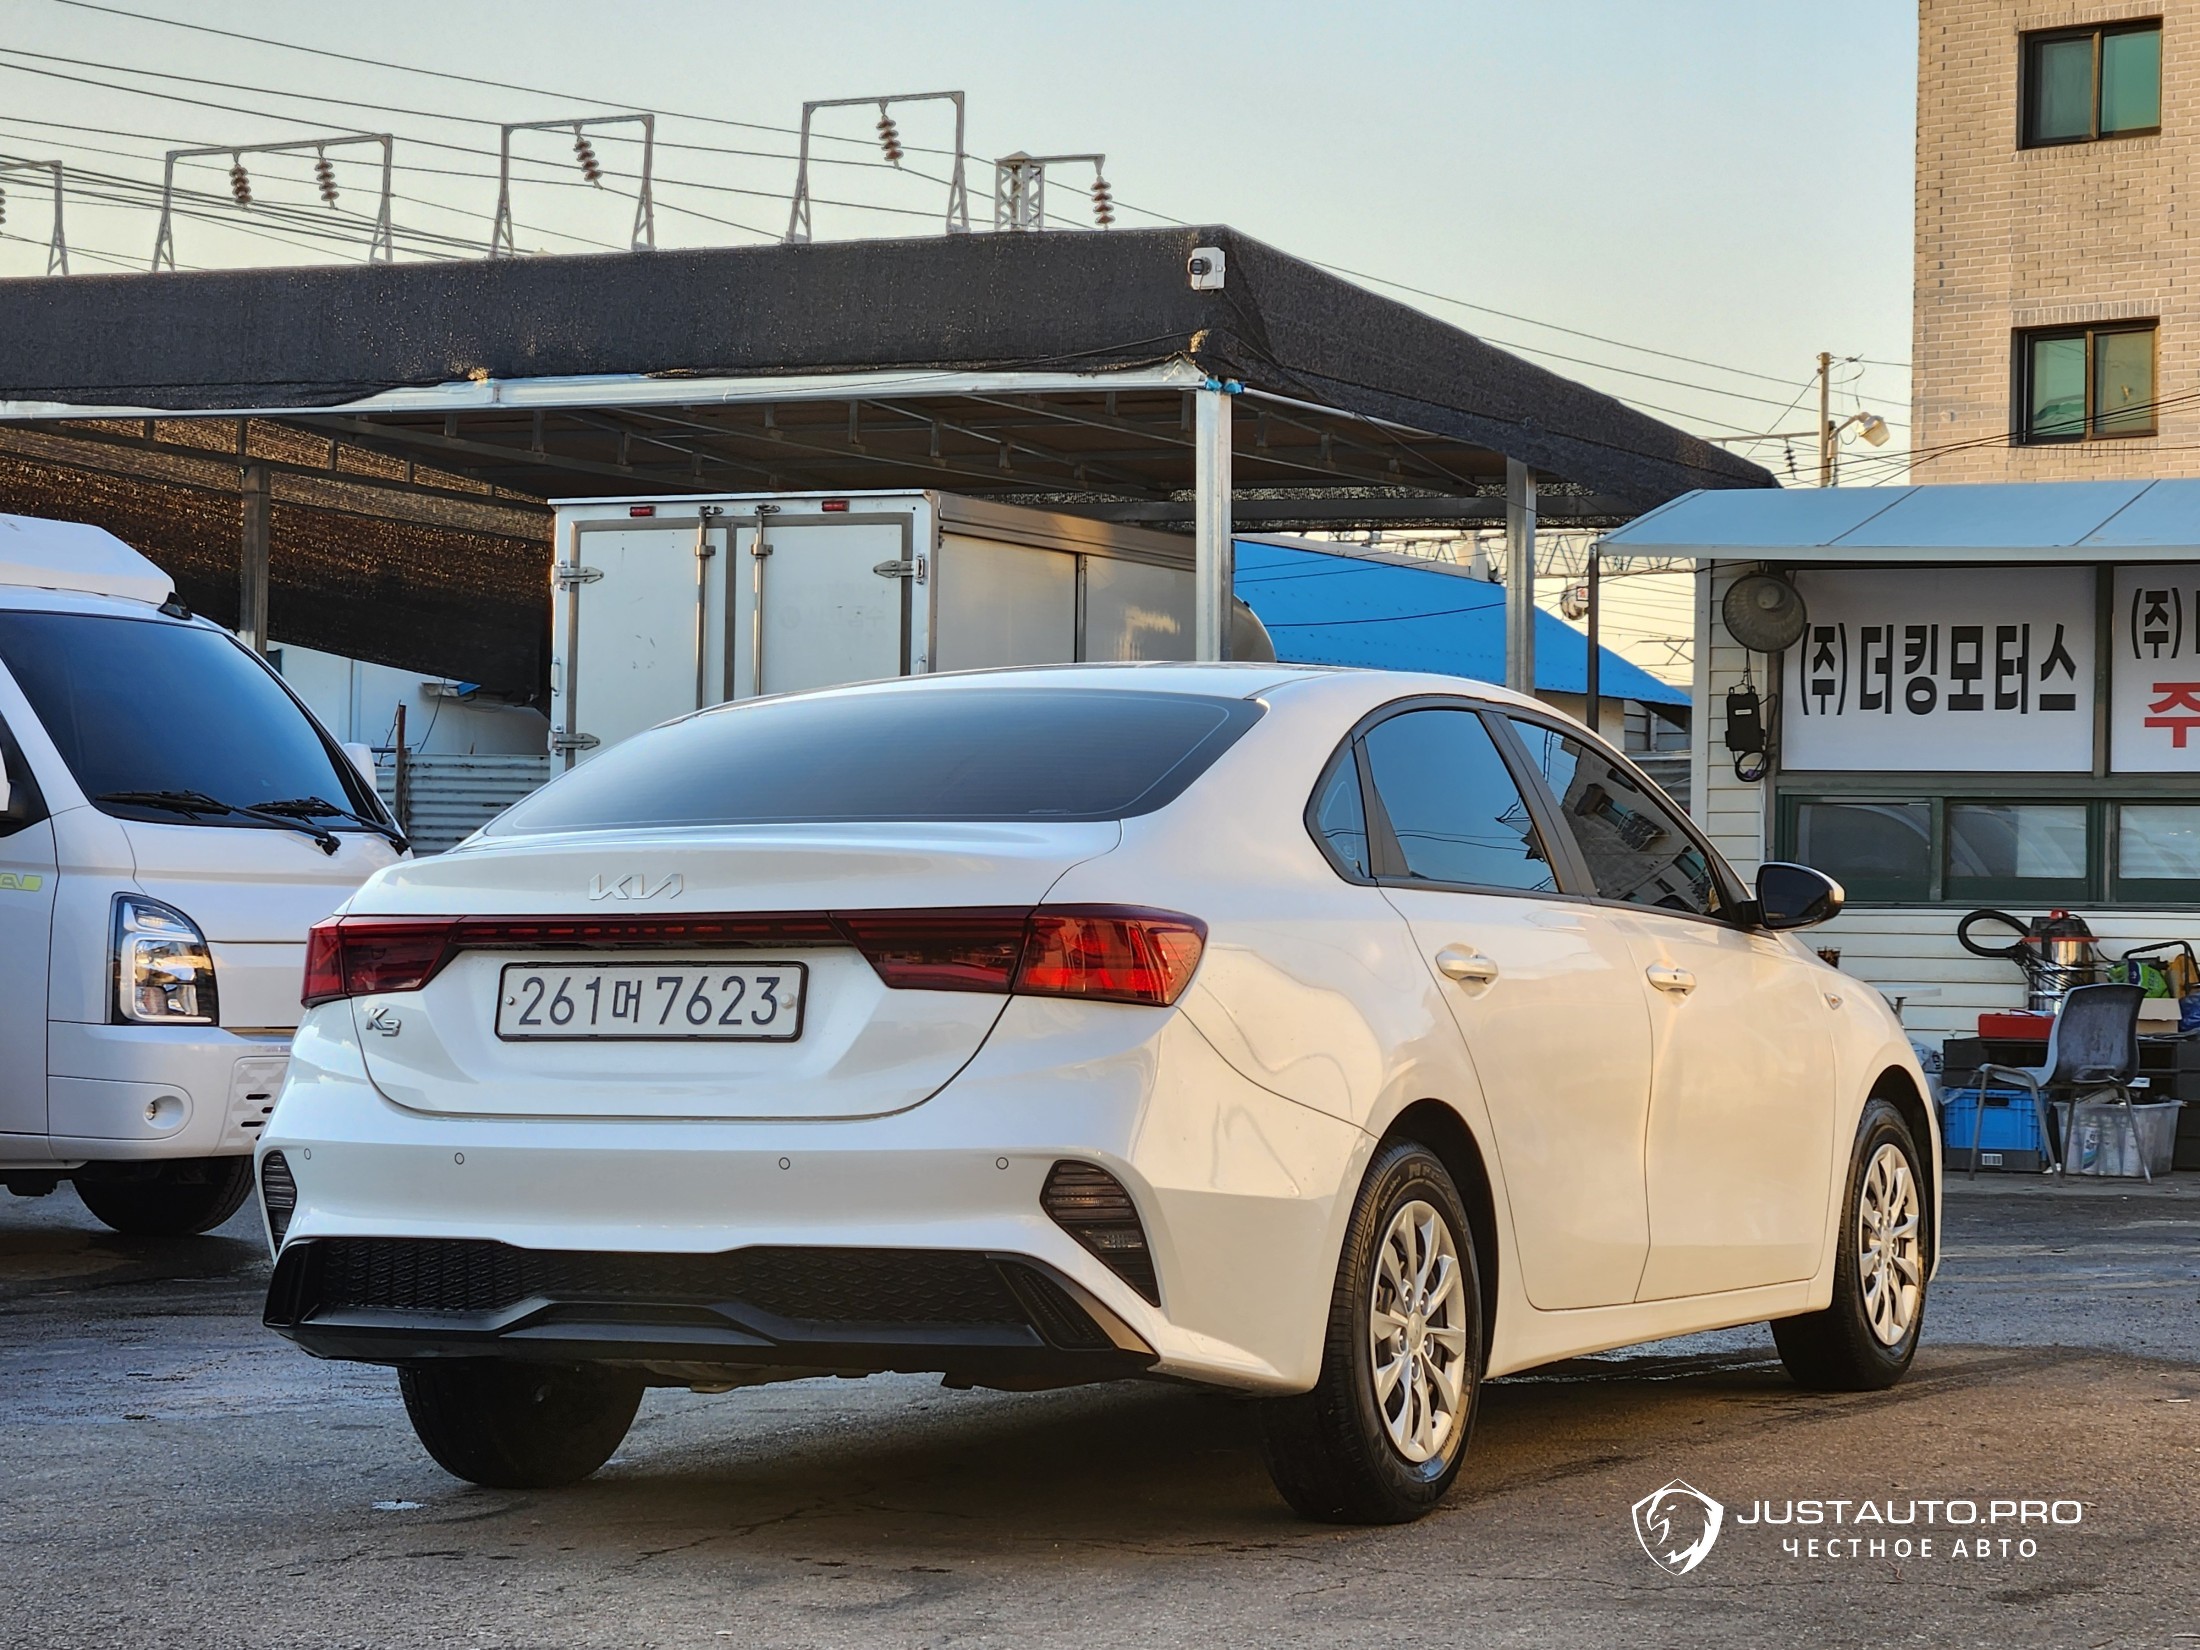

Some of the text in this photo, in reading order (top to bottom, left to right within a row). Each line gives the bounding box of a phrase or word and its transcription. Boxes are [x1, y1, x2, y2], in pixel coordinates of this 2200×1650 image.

[2131, 588, 2200, 659] (주)
[587, 873, 684, 901] KIA
[365, 1007, 402, 1037] K3
